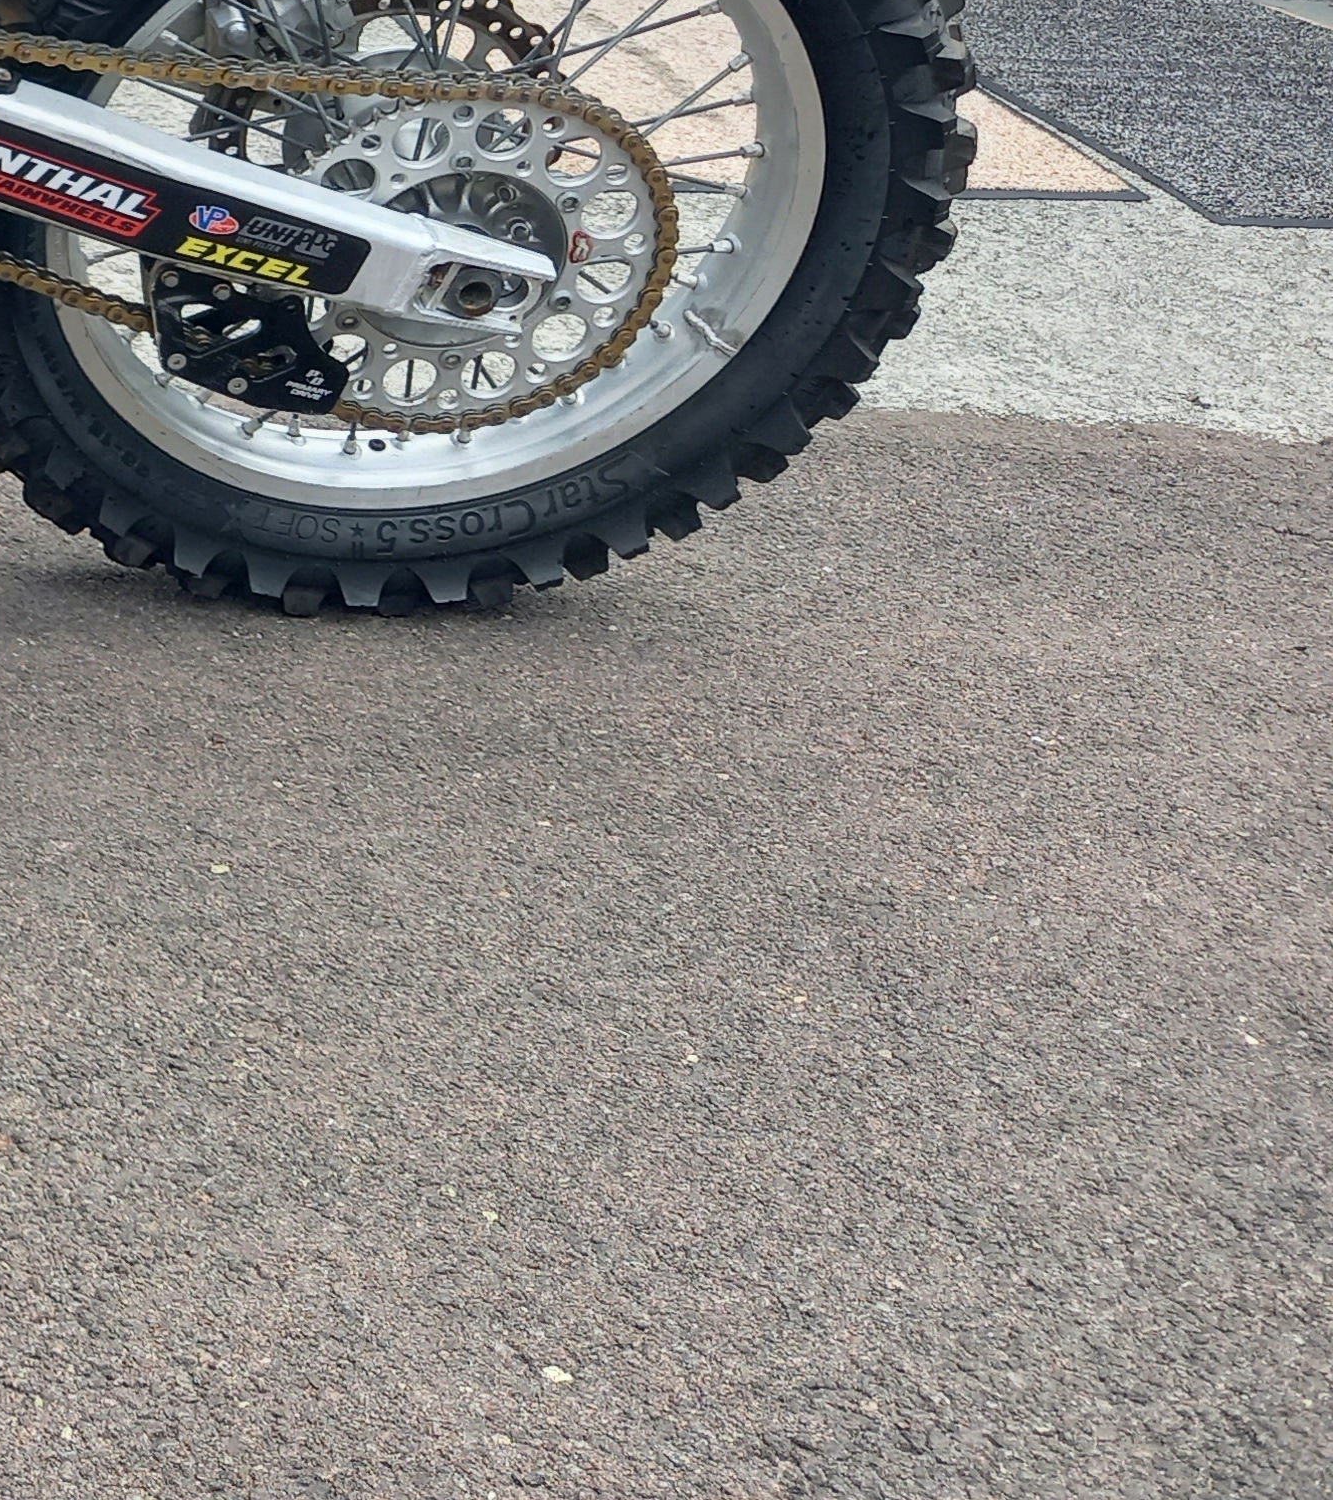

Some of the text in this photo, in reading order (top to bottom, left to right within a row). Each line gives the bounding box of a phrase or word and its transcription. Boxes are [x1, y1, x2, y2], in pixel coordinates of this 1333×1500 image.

[196, 205, 230, 231] VP
[176, 236, 310, 286] EXCEL
[285, 380, 333, 396] PRIMARY
[290, 388, 322, 400] DRIVE
[253, 513, 341, 543] SOFT
